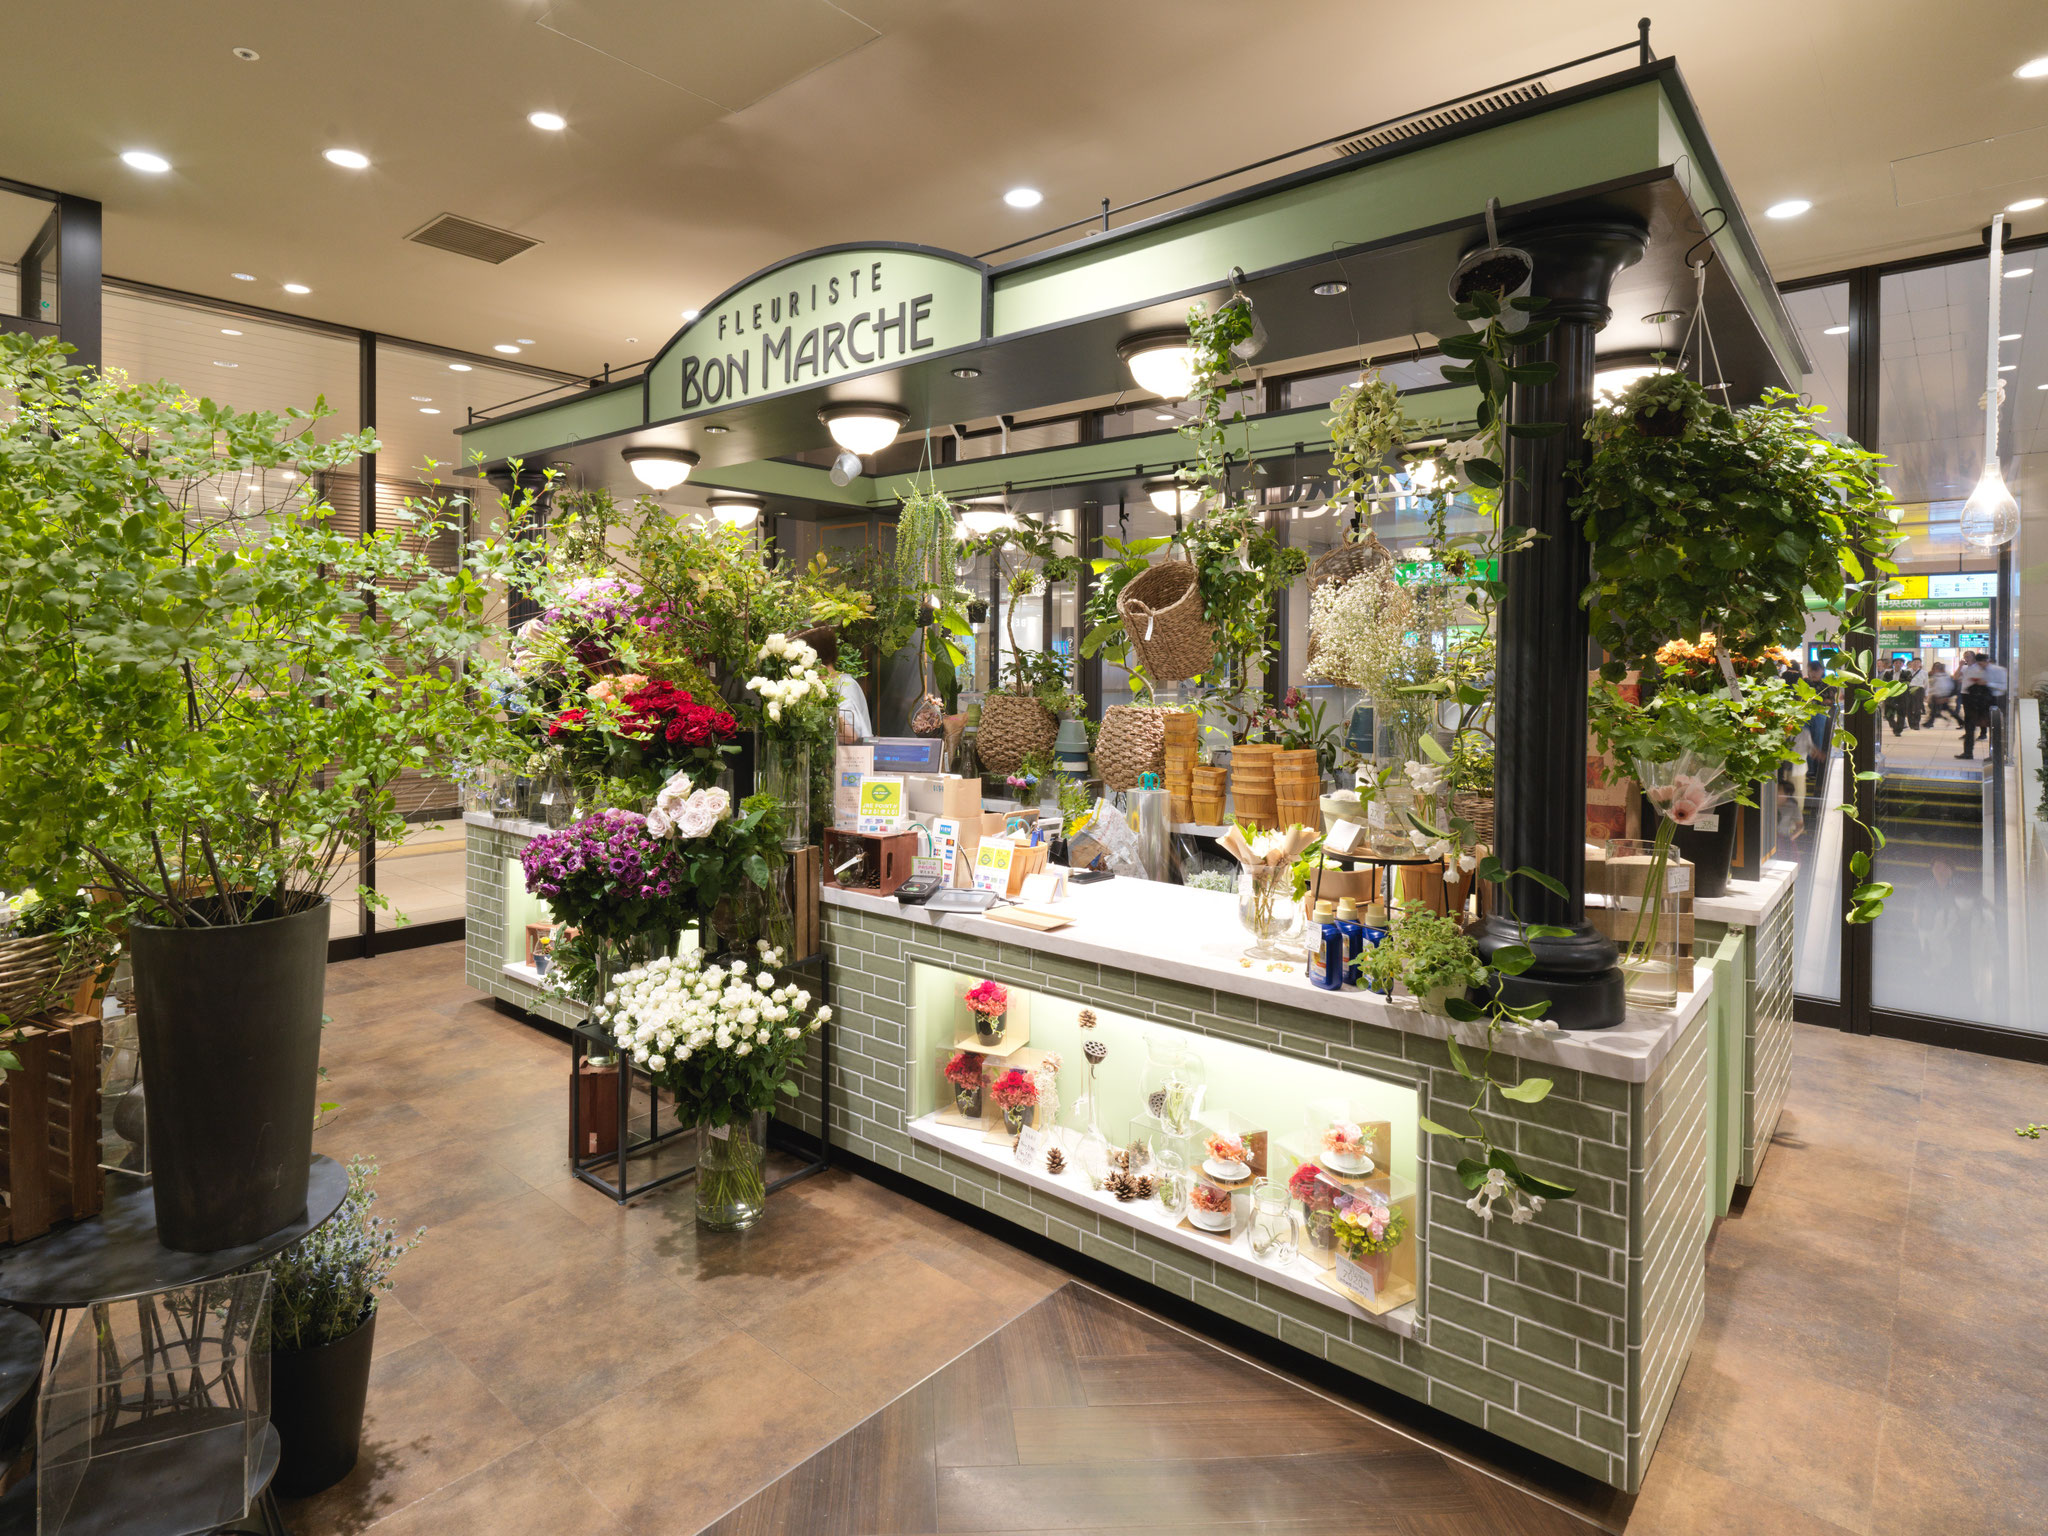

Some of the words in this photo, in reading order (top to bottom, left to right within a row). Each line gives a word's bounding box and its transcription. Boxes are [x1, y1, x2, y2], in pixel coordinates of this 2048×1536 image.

[717, 262, 882, 340] FLEURISTE
[681, 349, 750, 410] BON
[762, 293, 934, 389] MARCHE
[1877, 599, 1925, 608] 中央改札
